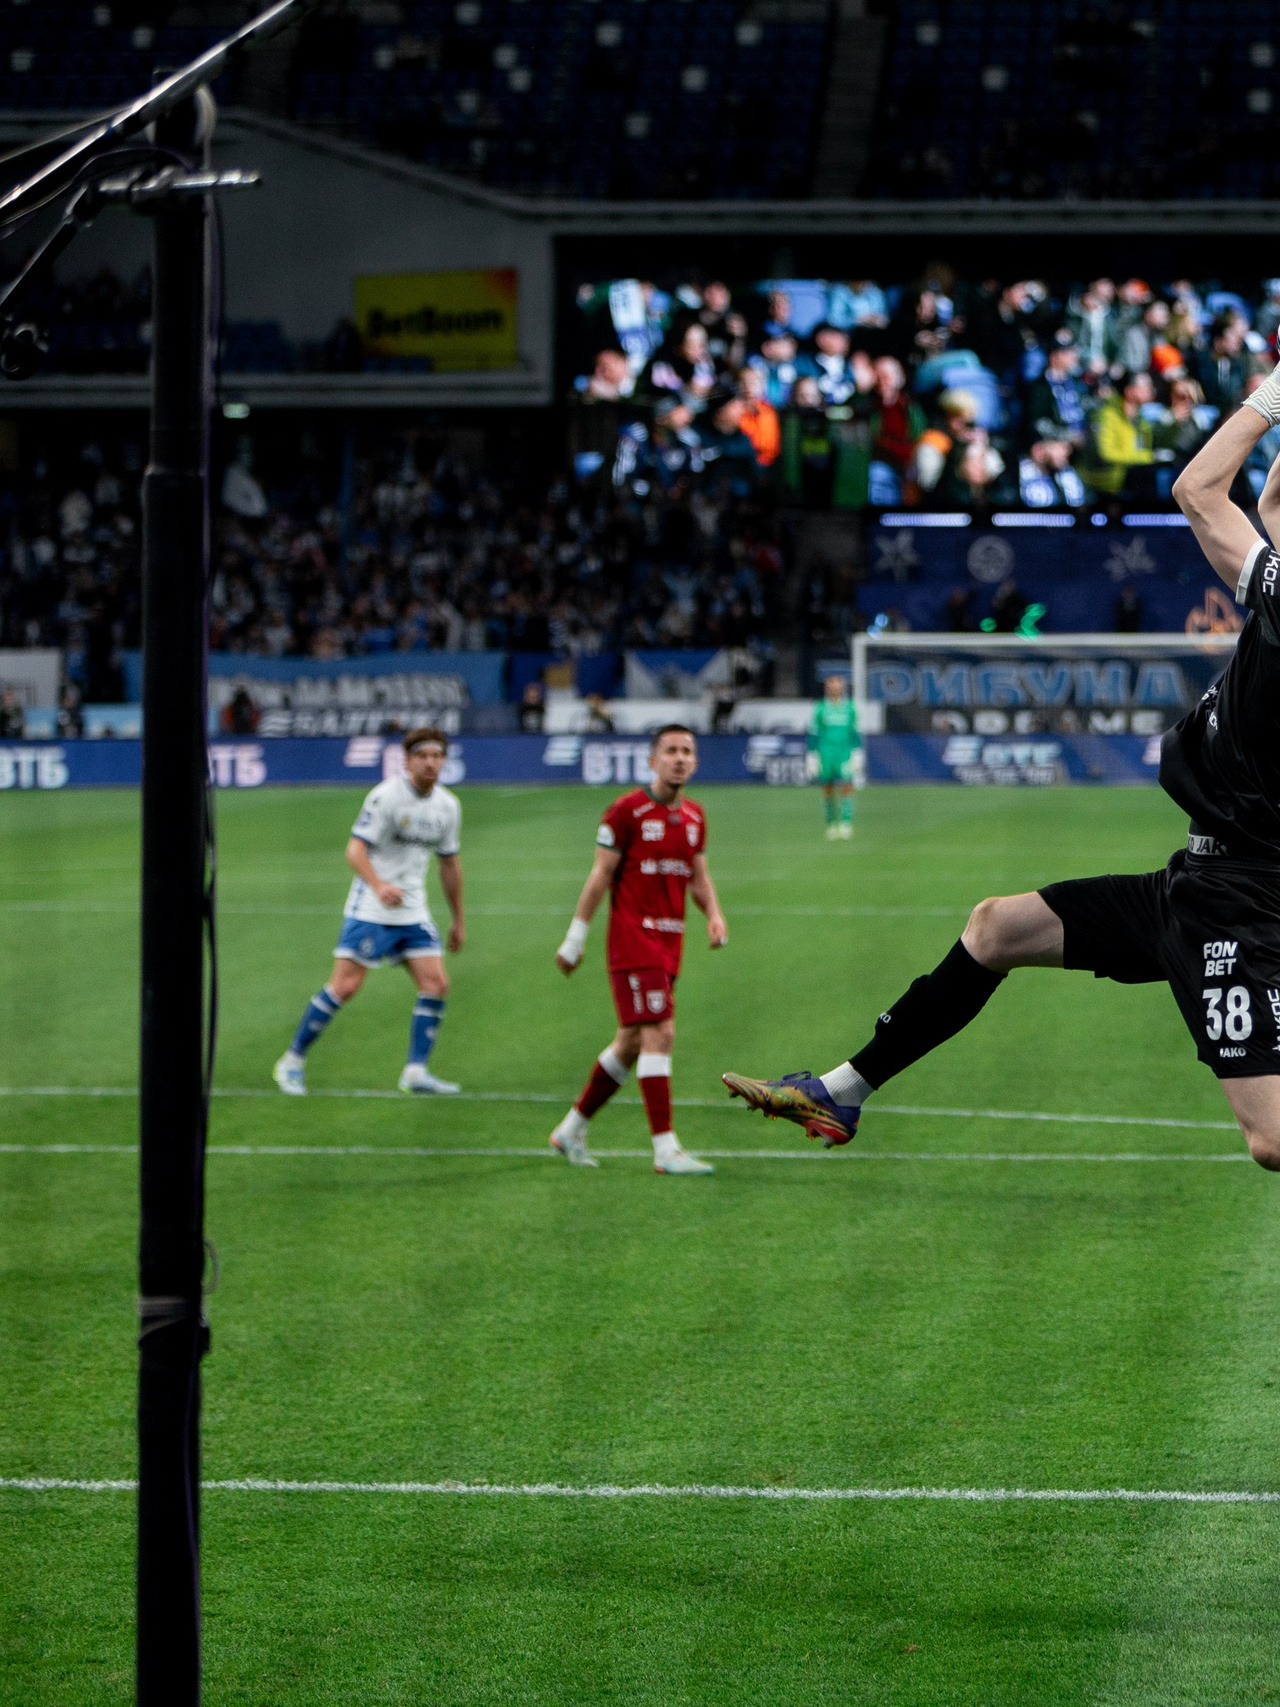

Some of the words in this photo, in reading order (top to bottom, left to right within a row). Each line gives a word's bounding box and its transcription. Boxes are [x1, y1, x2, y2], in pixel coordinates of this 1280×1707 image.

[208, 744, 267, 787] ТБ
[1203, 941, 1238, 959] FON
[1204, 958, 1237, 977] BET
[1202, 985, 1252, 1041] 38
